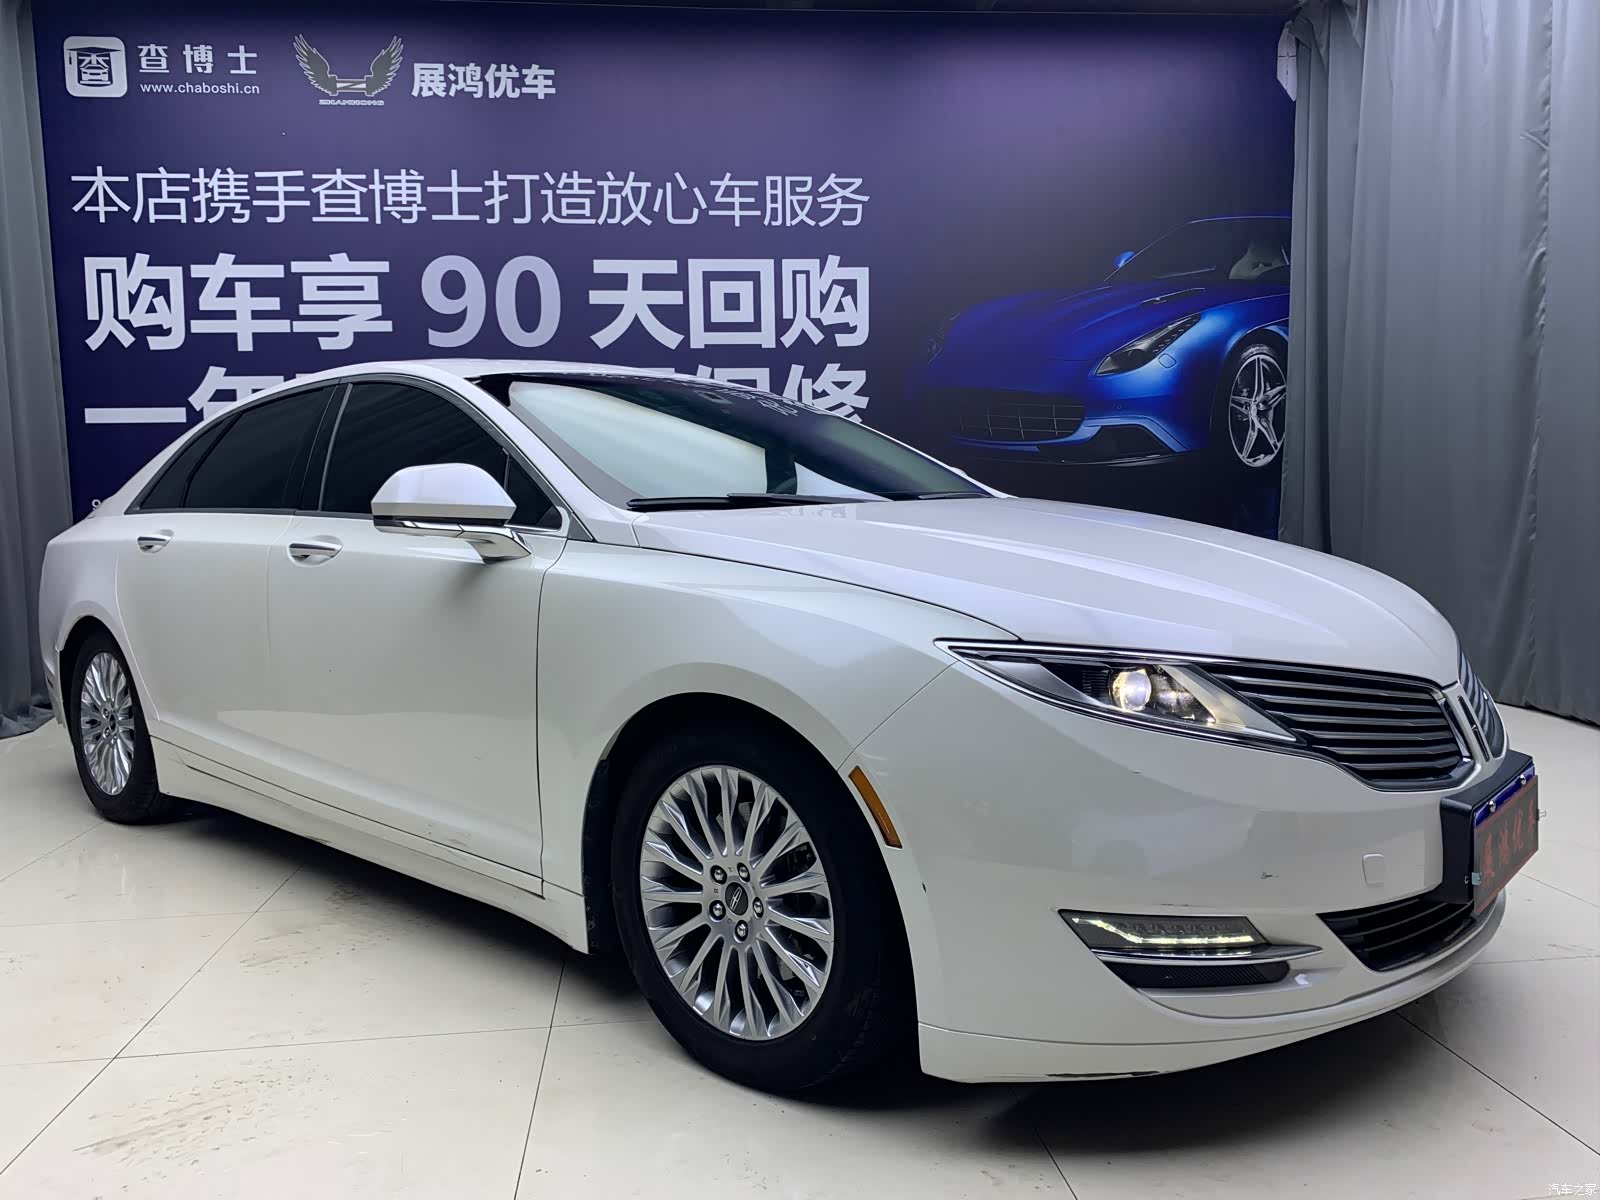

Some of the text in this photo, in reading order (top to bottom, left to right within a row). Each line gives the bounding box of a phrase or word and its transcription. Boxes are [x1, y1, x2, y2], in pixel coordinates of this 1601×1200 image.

[137, 43, 258, 75] 查博士
[139, 81, 260, 95] www.chaboshi.cn
[410, 62, 557, 100] 展鸿优车
[71, 165, 871, 228] 本店携手查博士打造放心车服务
[83, 252, 871, 352] 购车享 90 天回购
